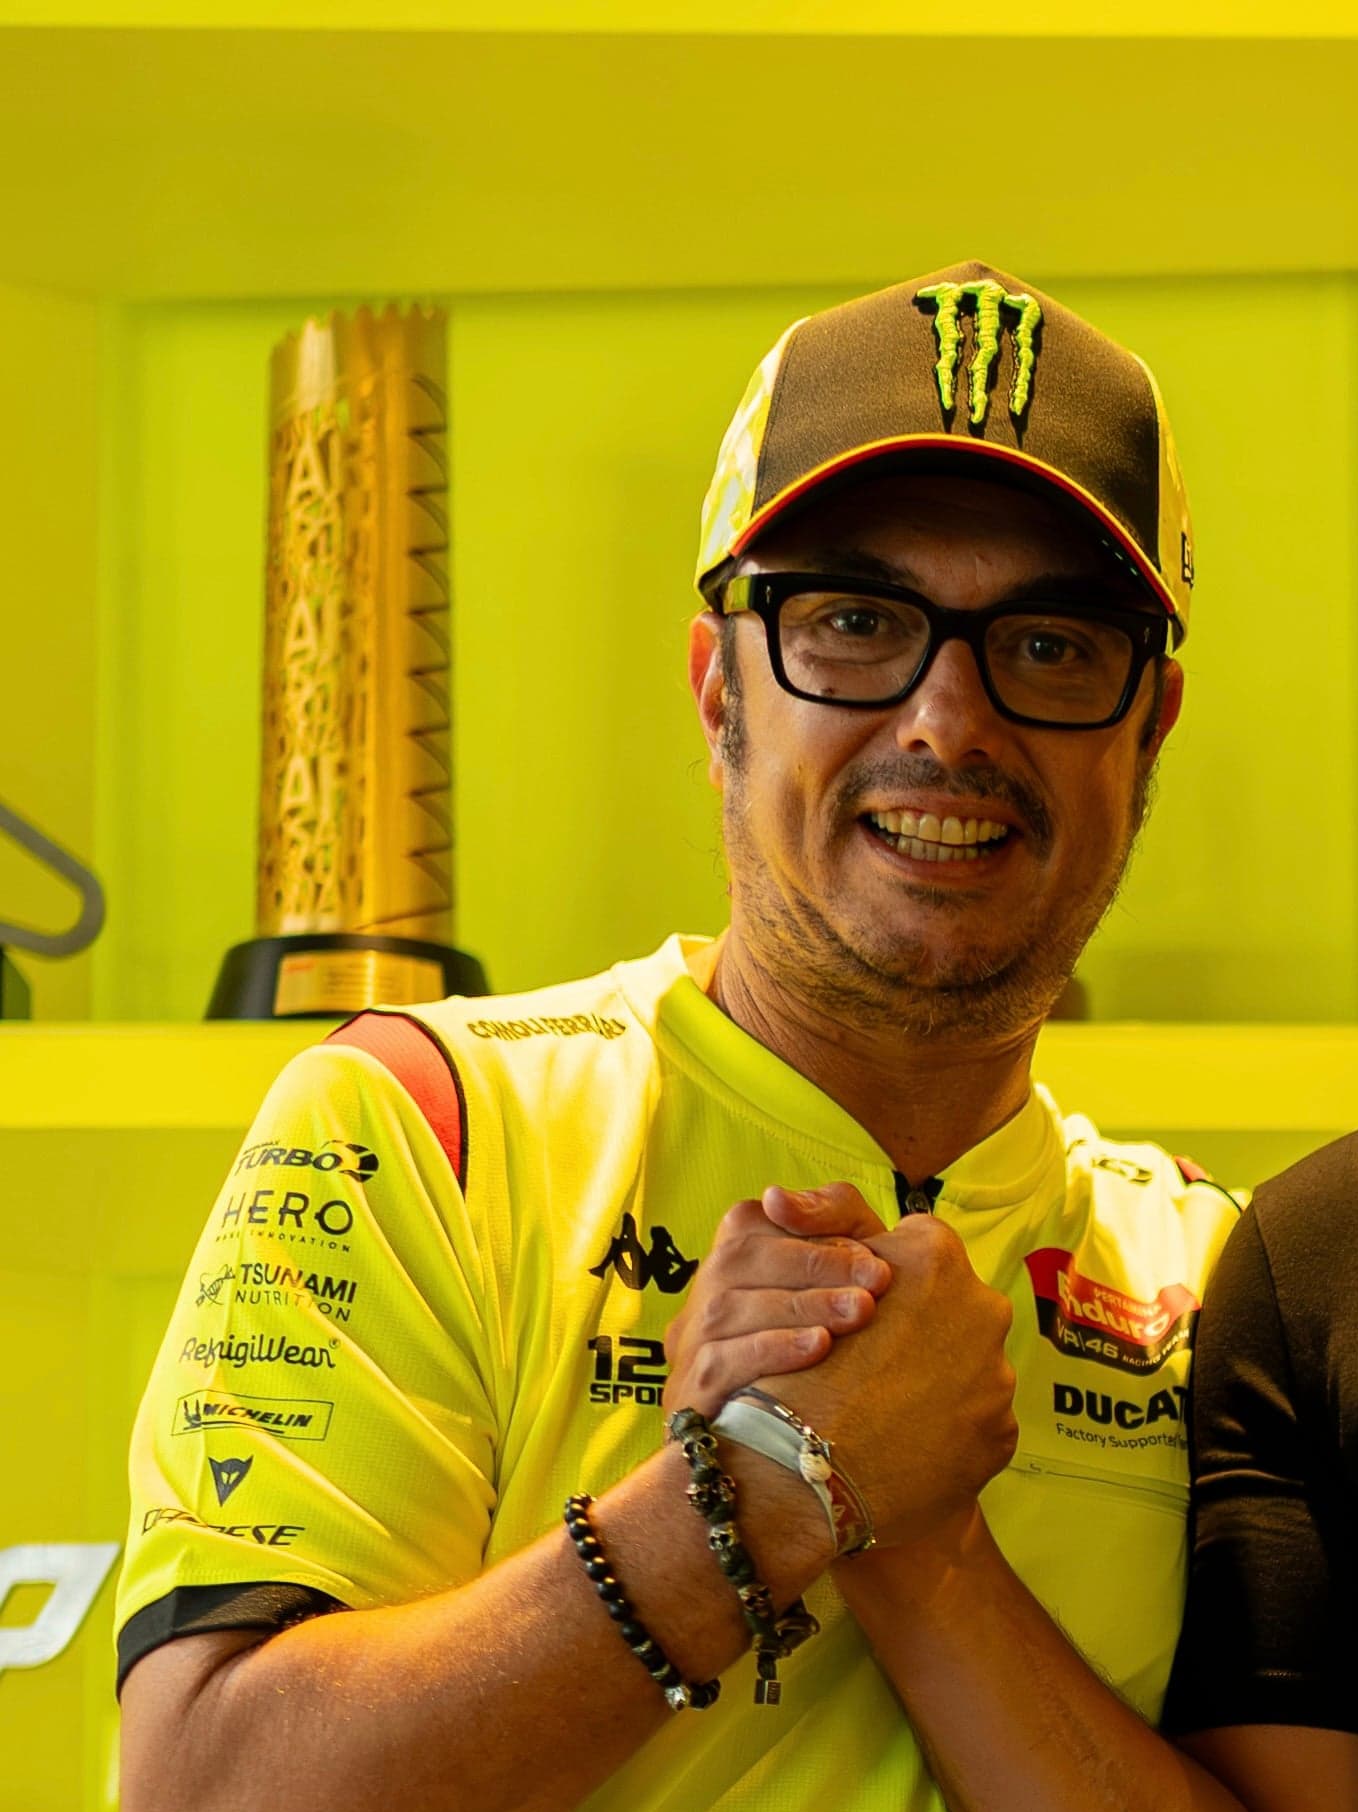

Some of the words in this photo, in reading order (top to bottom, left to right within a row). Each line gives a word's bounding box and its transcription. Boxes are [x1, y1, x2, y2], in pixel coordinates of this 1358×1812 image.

[221, 1189, 353, 1236] HERO
[240, 1262, 358, 1304] TSUNAMI
[202, 1402, 314, 1428] MICHELIN
[1056, 1422, 1107, 1447] Factory
